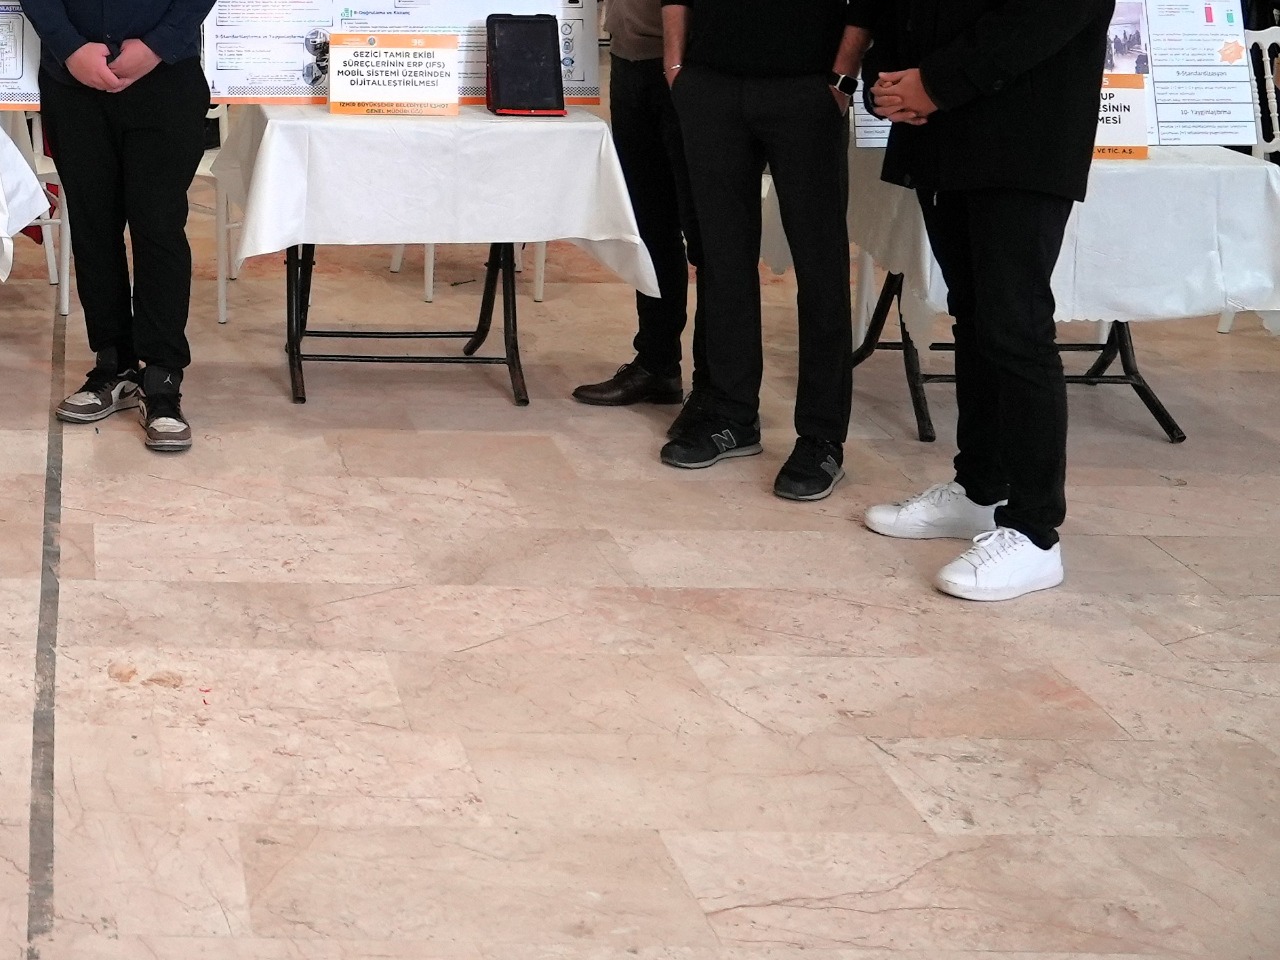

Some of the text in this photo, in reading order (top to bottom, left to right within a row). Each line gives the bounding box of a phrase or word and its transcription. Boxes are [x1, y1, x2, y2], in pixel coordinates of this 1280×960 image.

[353, 50, 435, 59] GEZİCİ TAMİR EKİBİ
[342, 59, 404, 68] SÜREÇLERİNİN
[425, 60, 446, 69] (IFS)
[337, 68, 451, 78] MOBİL SİSTEMİ ÜZERİNDEN
[349, 78, 439, 87] DİJİTALLEŞTİRİLMESİ
